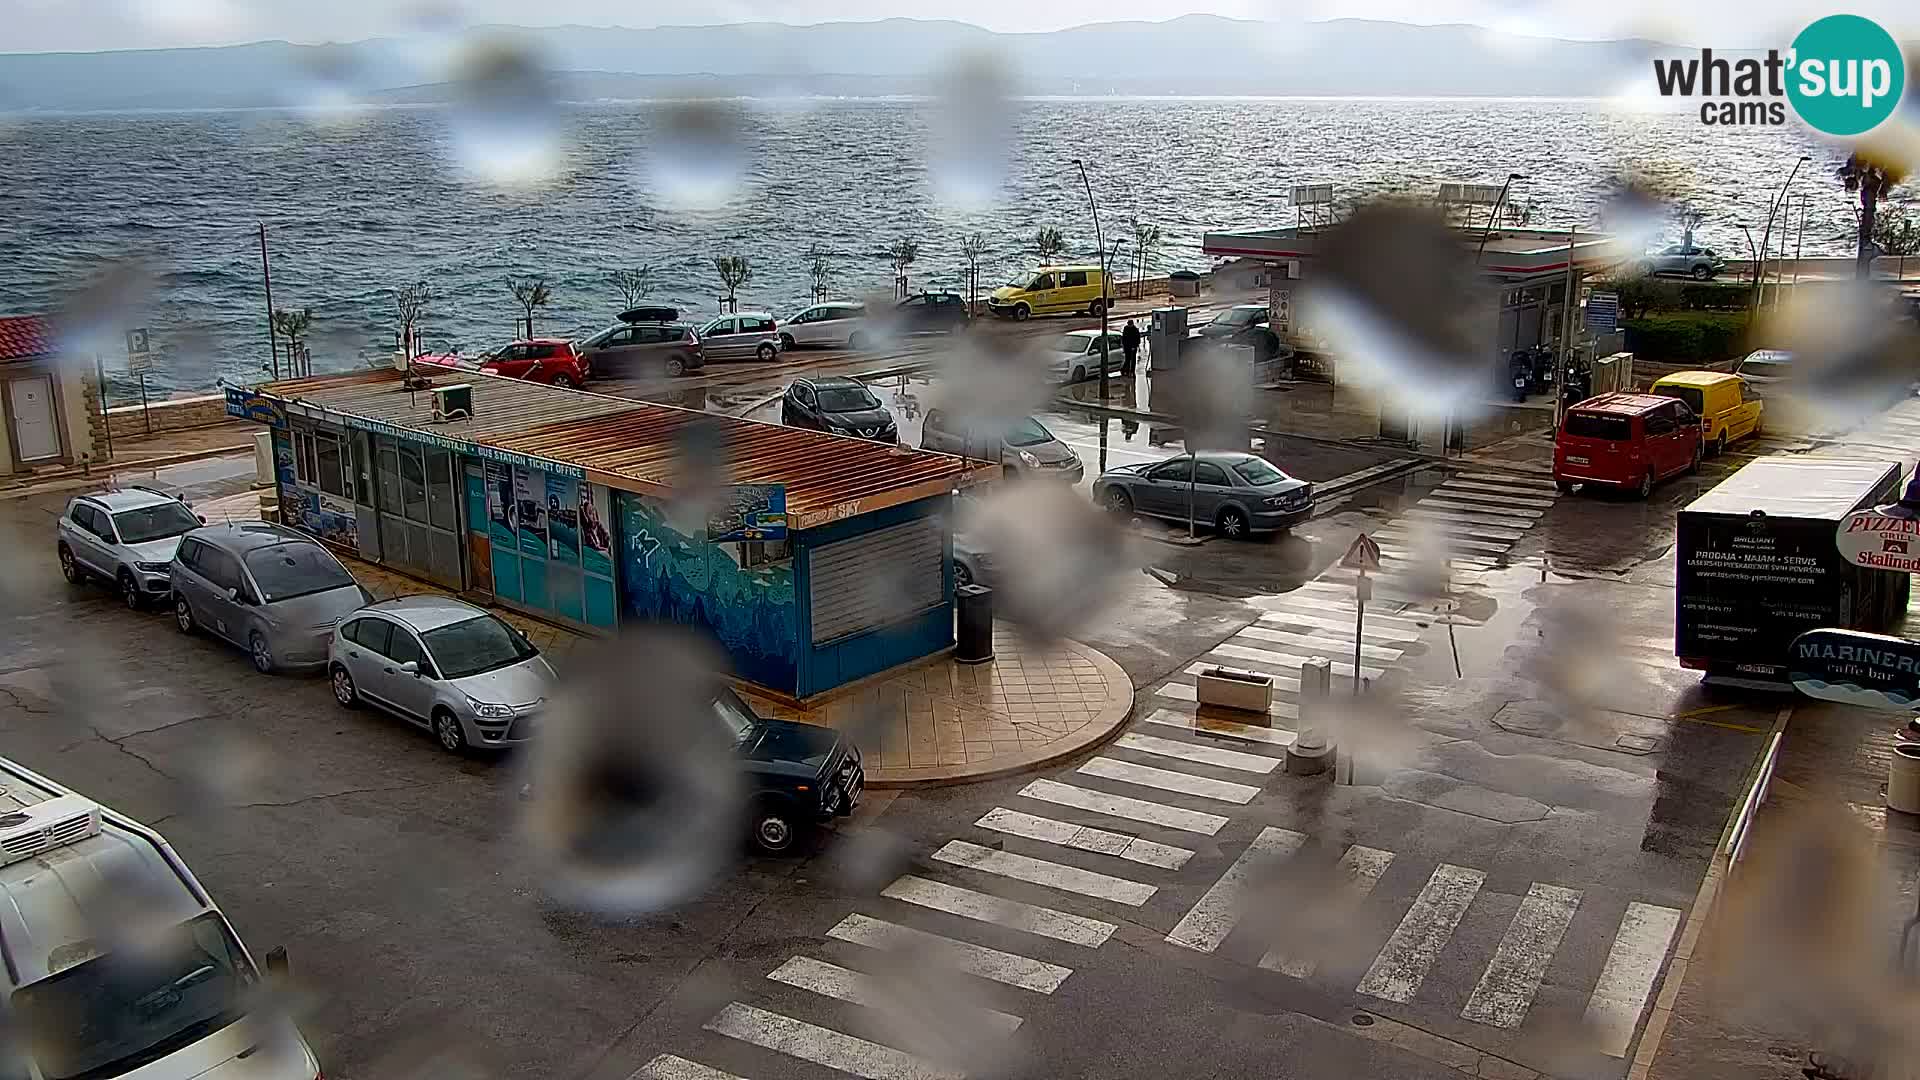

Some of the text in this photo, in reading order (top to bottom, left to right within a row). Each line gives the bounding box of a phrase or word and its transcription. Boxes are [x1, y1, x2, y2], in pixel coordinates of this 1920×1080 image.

[131, 332, 144, 351] P
[396, 428, 435, 445] AUTOBUSNA
[436, 437, 468, 453] POSTAJA
[477, 446, 493, 458] BUS
[494, 451, 526, 466] STATION
[528, 458, 554, 472] TICKET
[555, 463, 583, 478] OFFICE
[1880, 531, 1915, 542] GRILL
[1695, 551, 1817, 566] PRODAJA NAJAM SERVIS
[1827, 663, 1897, 681] caffe bar
